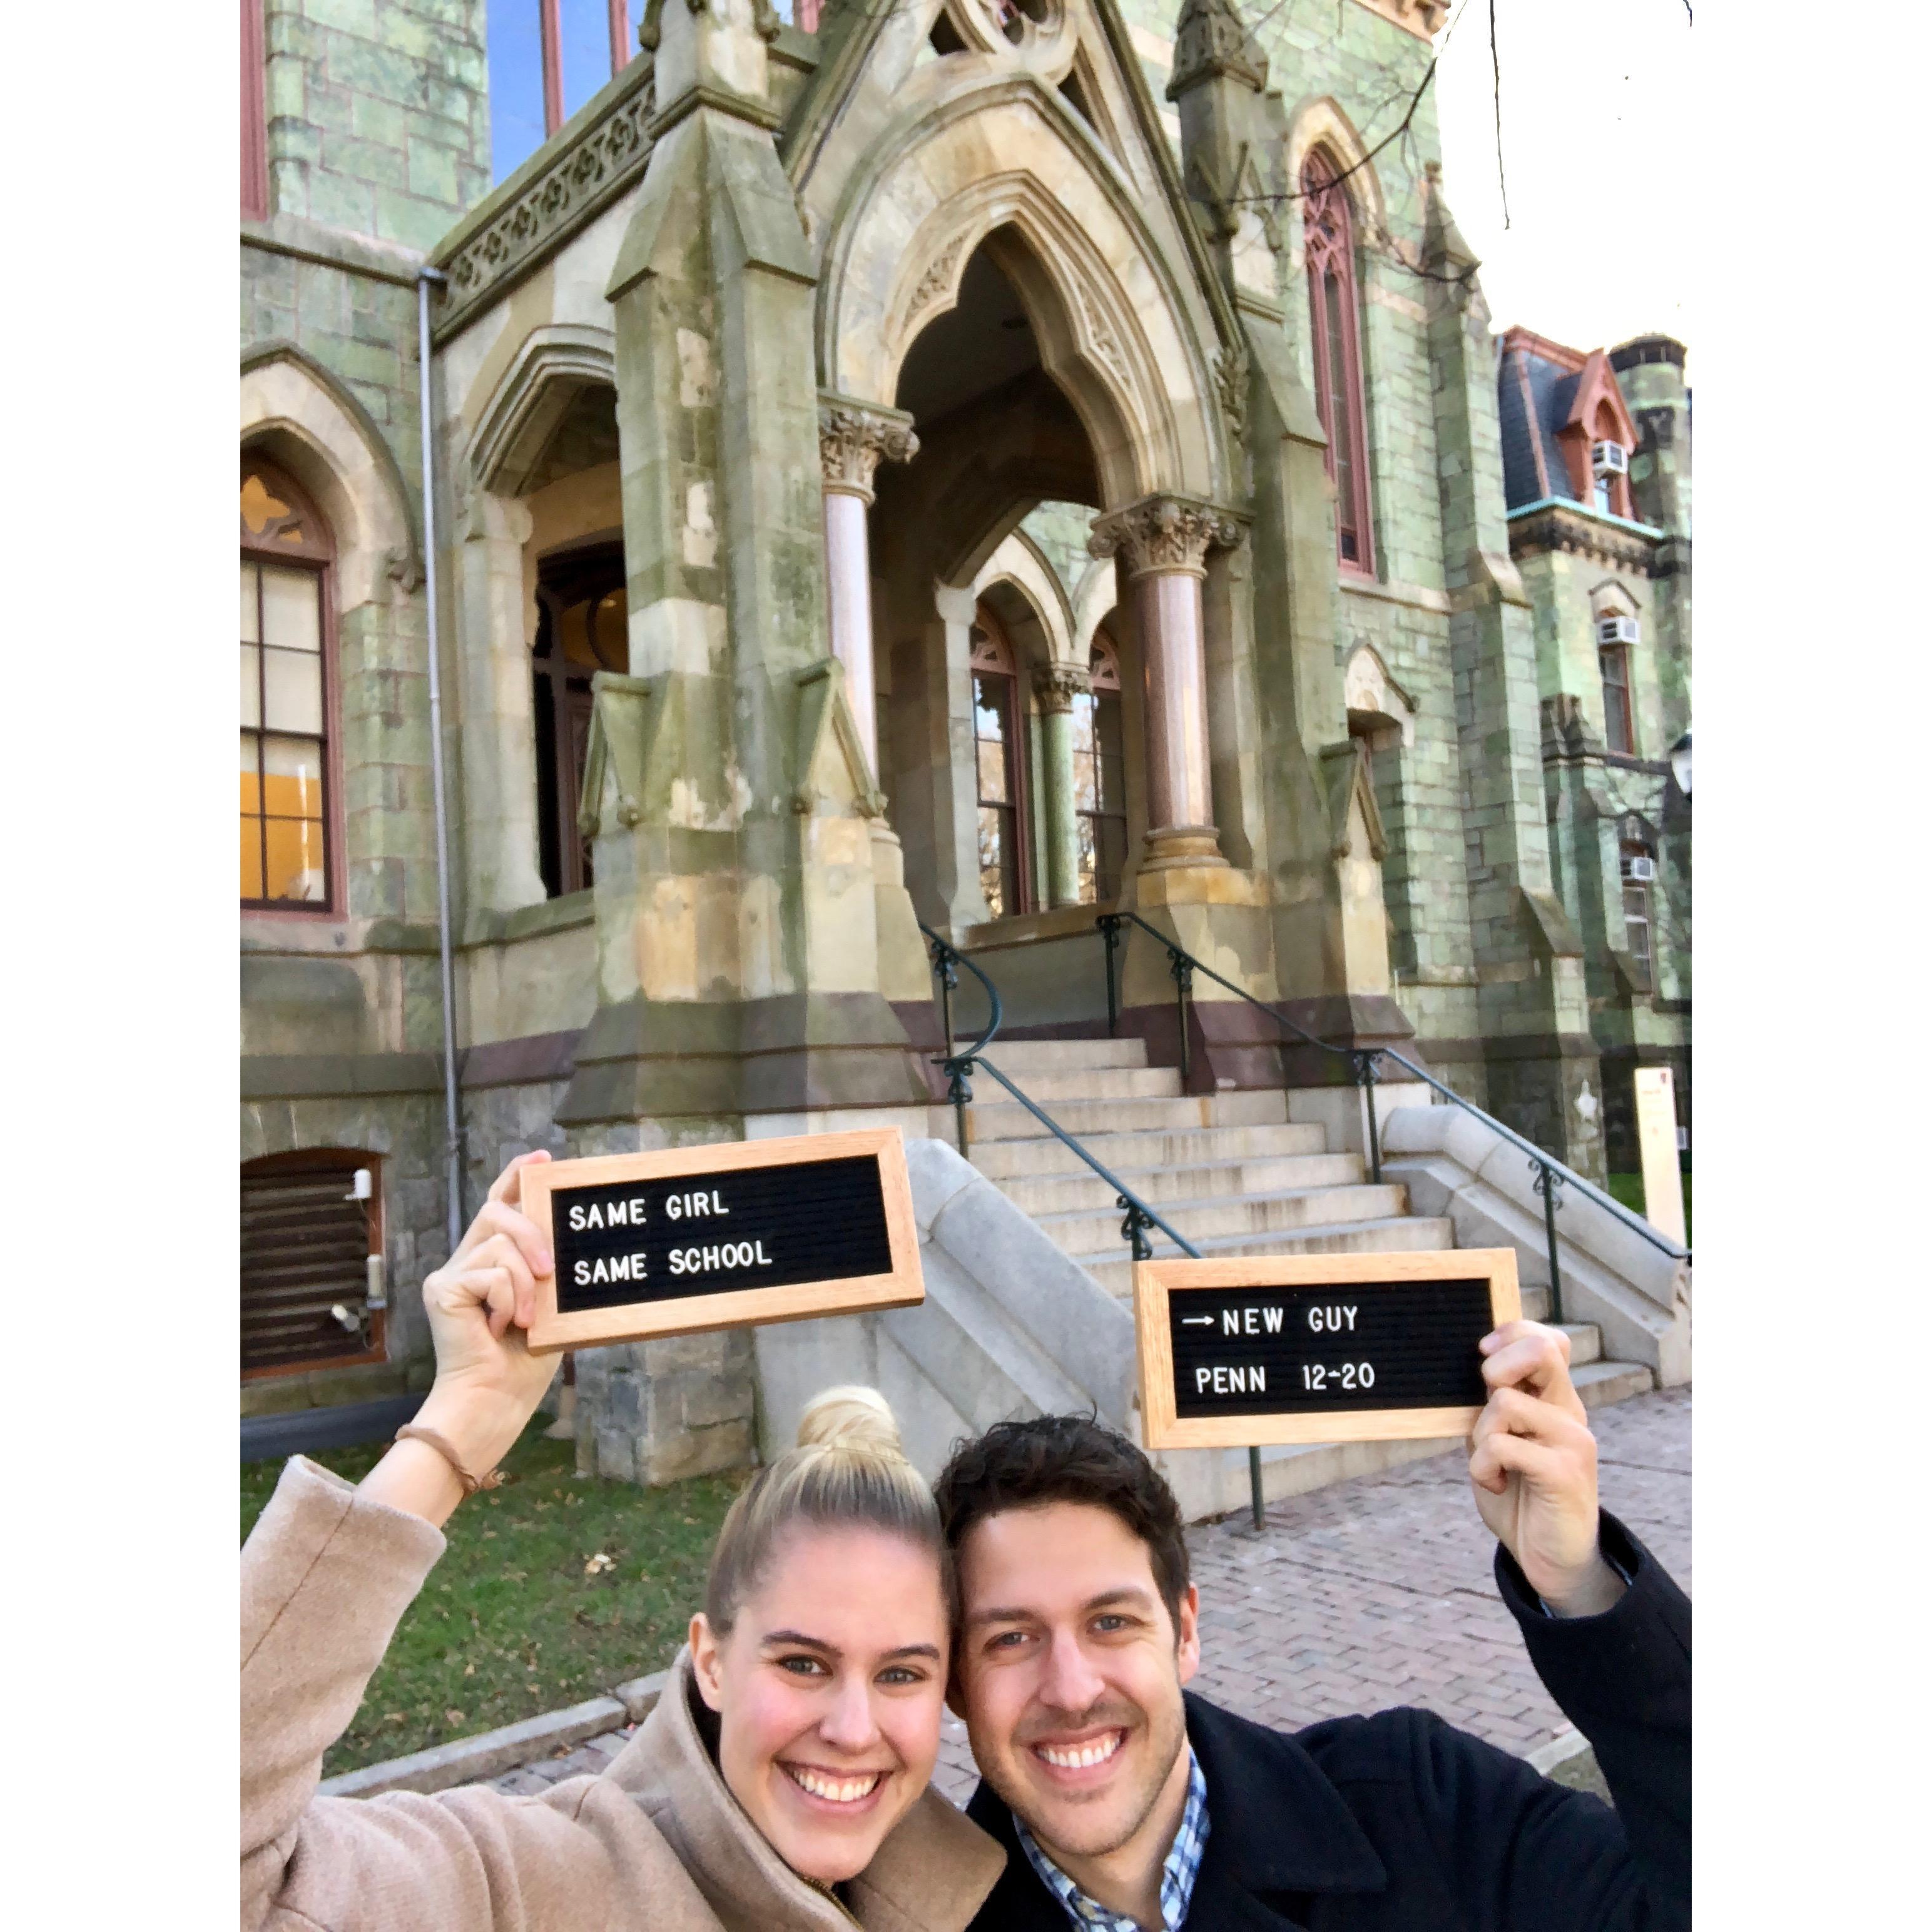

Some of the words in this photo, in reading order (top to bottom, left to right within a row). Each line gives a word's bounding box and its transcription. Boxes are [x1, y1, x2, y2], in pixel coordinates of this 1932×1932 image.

[569, 1197, 647, 1231] SAME
[665, 1190, 730, 1220] GIRL
[574, 1253, 648, 1286] SAME
[668, 1240, 773, 1275] SCHOOL
[1222, 1307, 1284, 1336] NEW
[1308, 1305, 1358, 1333] GUY
[1195, 1366, 1266, 1394] PENN
[1303, 1362, 1376, 1390] 12-20
